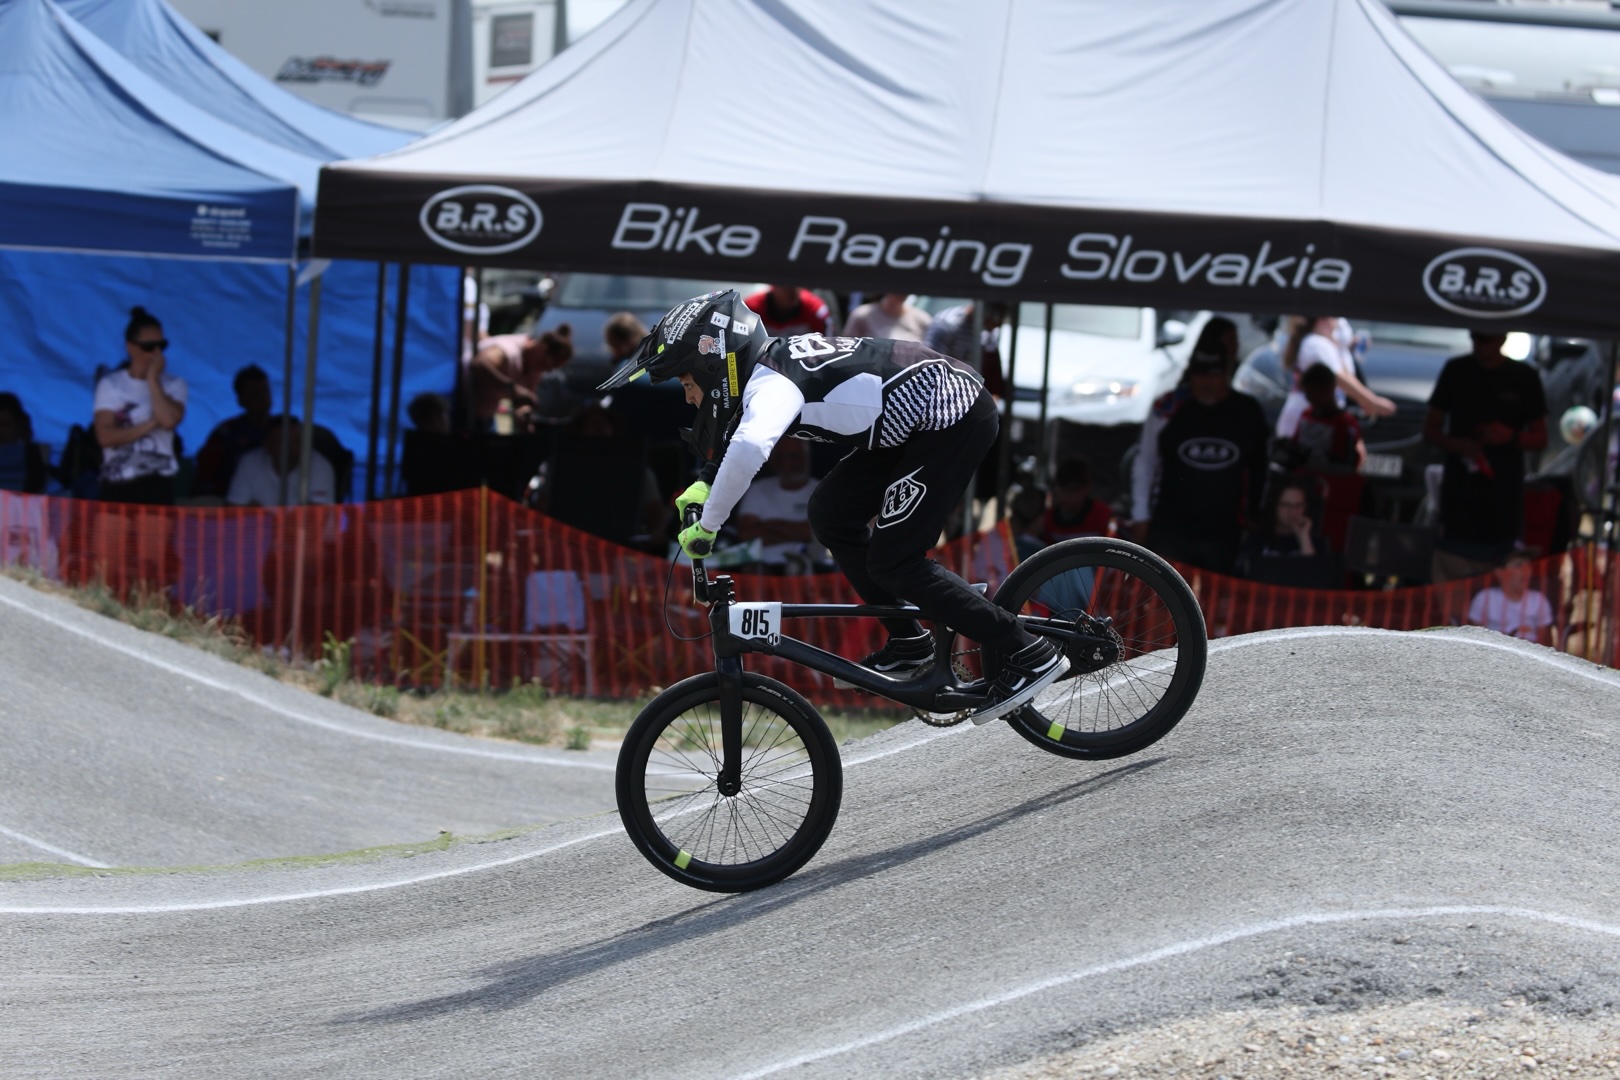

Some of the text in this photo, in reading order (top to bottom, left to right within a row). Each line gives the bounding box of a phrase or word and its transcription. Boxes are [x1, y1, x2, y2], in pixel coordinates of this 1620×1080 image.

[435, 201, 529, 234] B.R.S
[611, 202, 1352, 292] Bike Racing Slovakia
[1438, 263, 1533, 301] B.R.S
[728, 353, 736, 381] BREYER
[721, 377, 729, 409] MAGURA
[741, 608, 770, 636] 815
